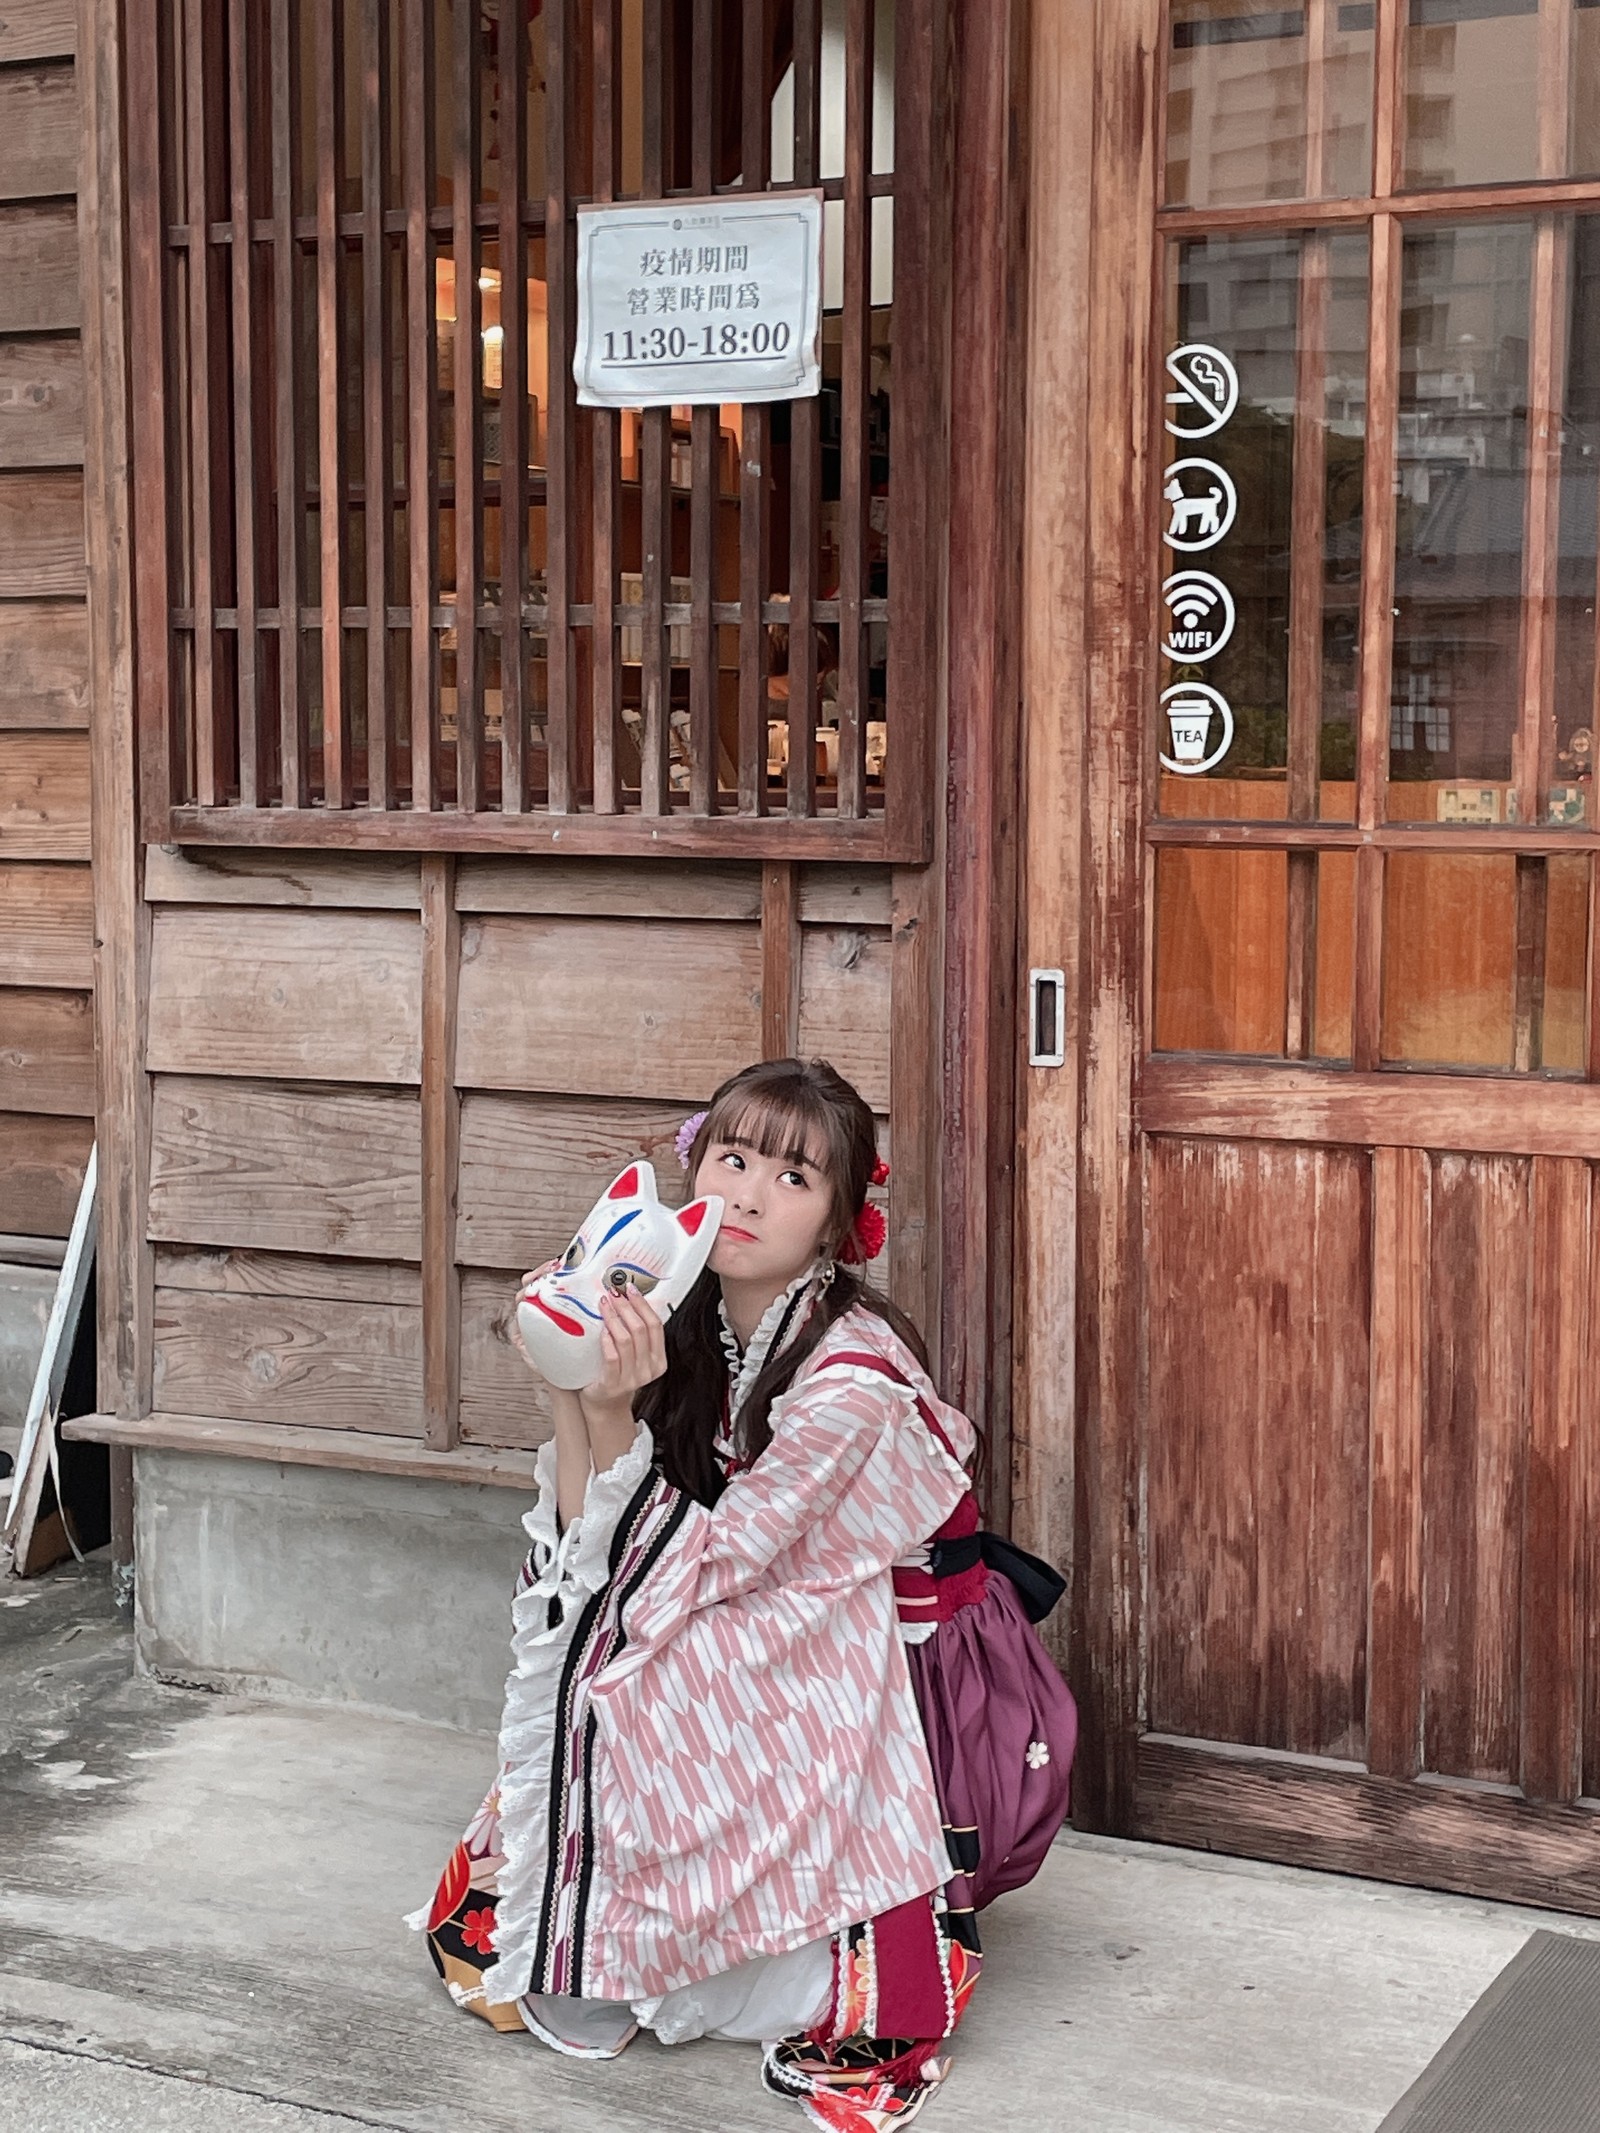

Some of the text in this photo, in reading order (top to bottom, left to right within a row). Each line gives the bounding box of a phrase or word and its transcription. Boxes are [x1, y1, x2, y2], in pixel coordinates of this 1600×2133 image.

[640, 245, 748, 277] 疫情期間
[602, 321, 790, 361] 11:30-18:00
[1168, 631, 1212, 649] WIFI
[1173, 730, 1204, 743] TEA
